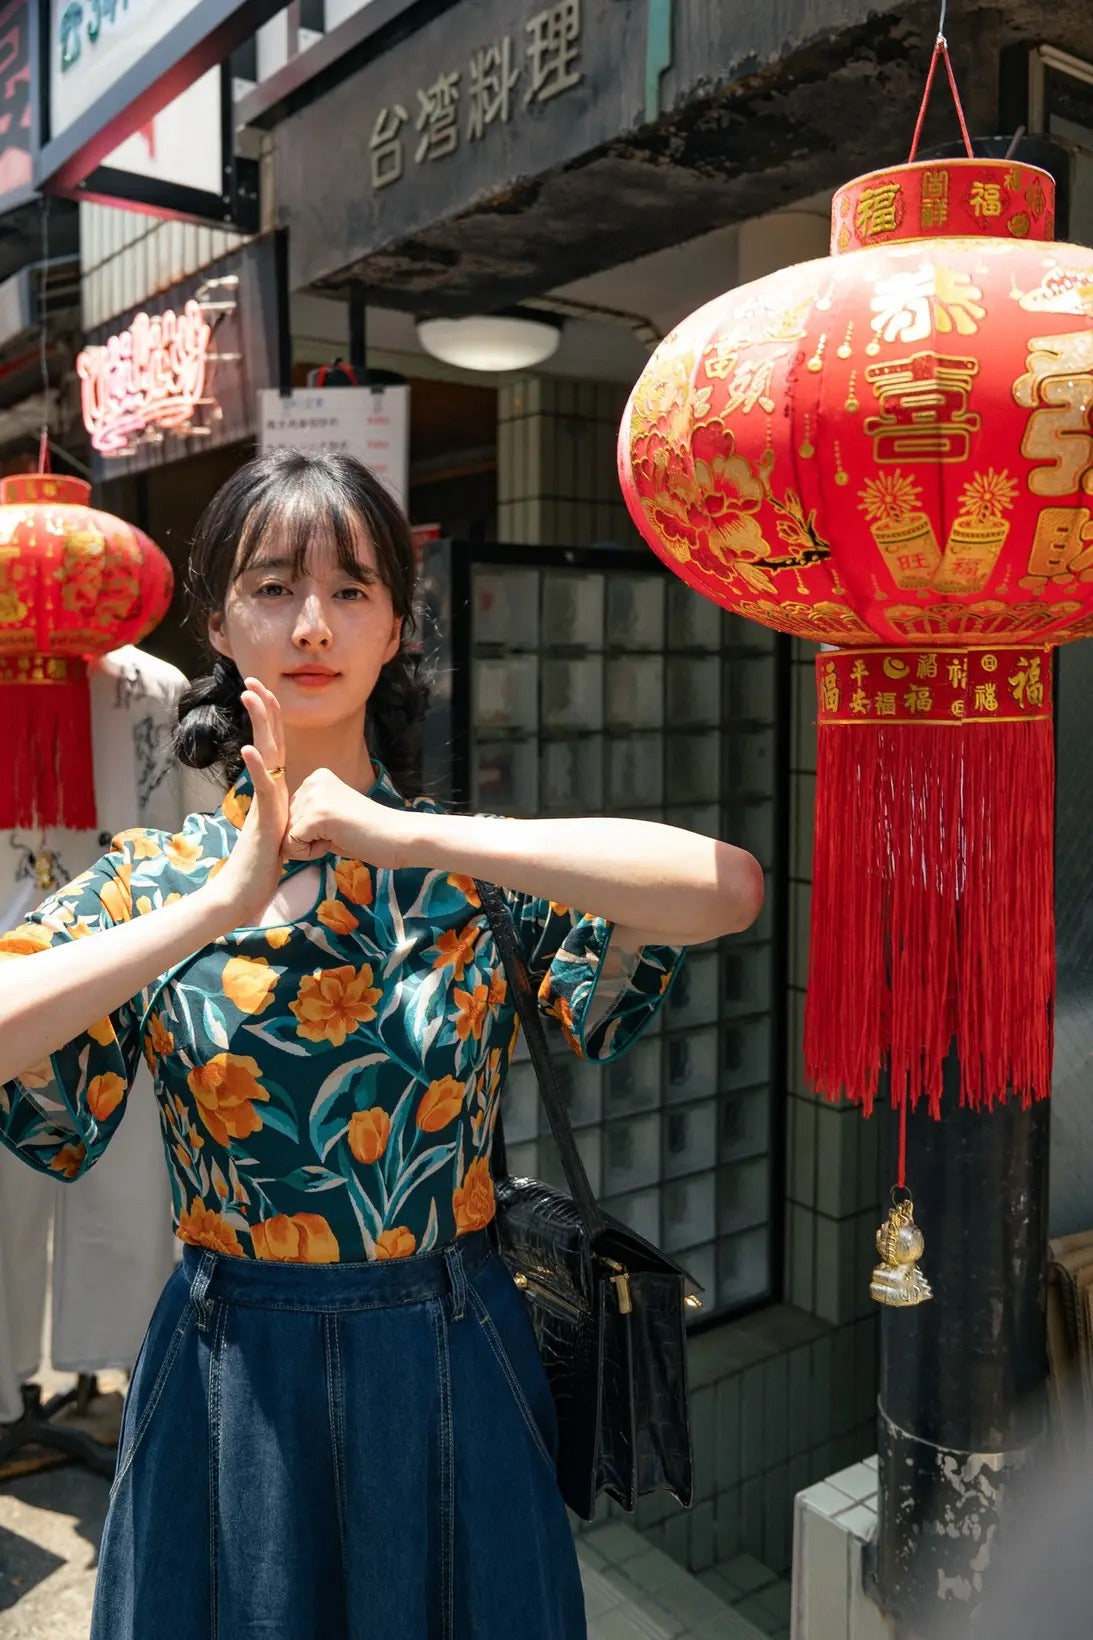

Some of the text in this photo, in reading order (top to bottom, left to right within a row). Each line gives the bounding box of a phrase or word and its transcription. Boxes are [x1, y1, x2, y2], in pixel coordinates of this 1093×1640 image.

[369, 0, 583, 188] 台湾料理
[855, 184, 901, 237] 福
[969, 181, 1002, 217] 福
[849, 659, 871, 714] 平安
[875, 691, 897, 716] 福
[904, 682, 933, 714] 福
[1007, 655, 1044, 710] 福
